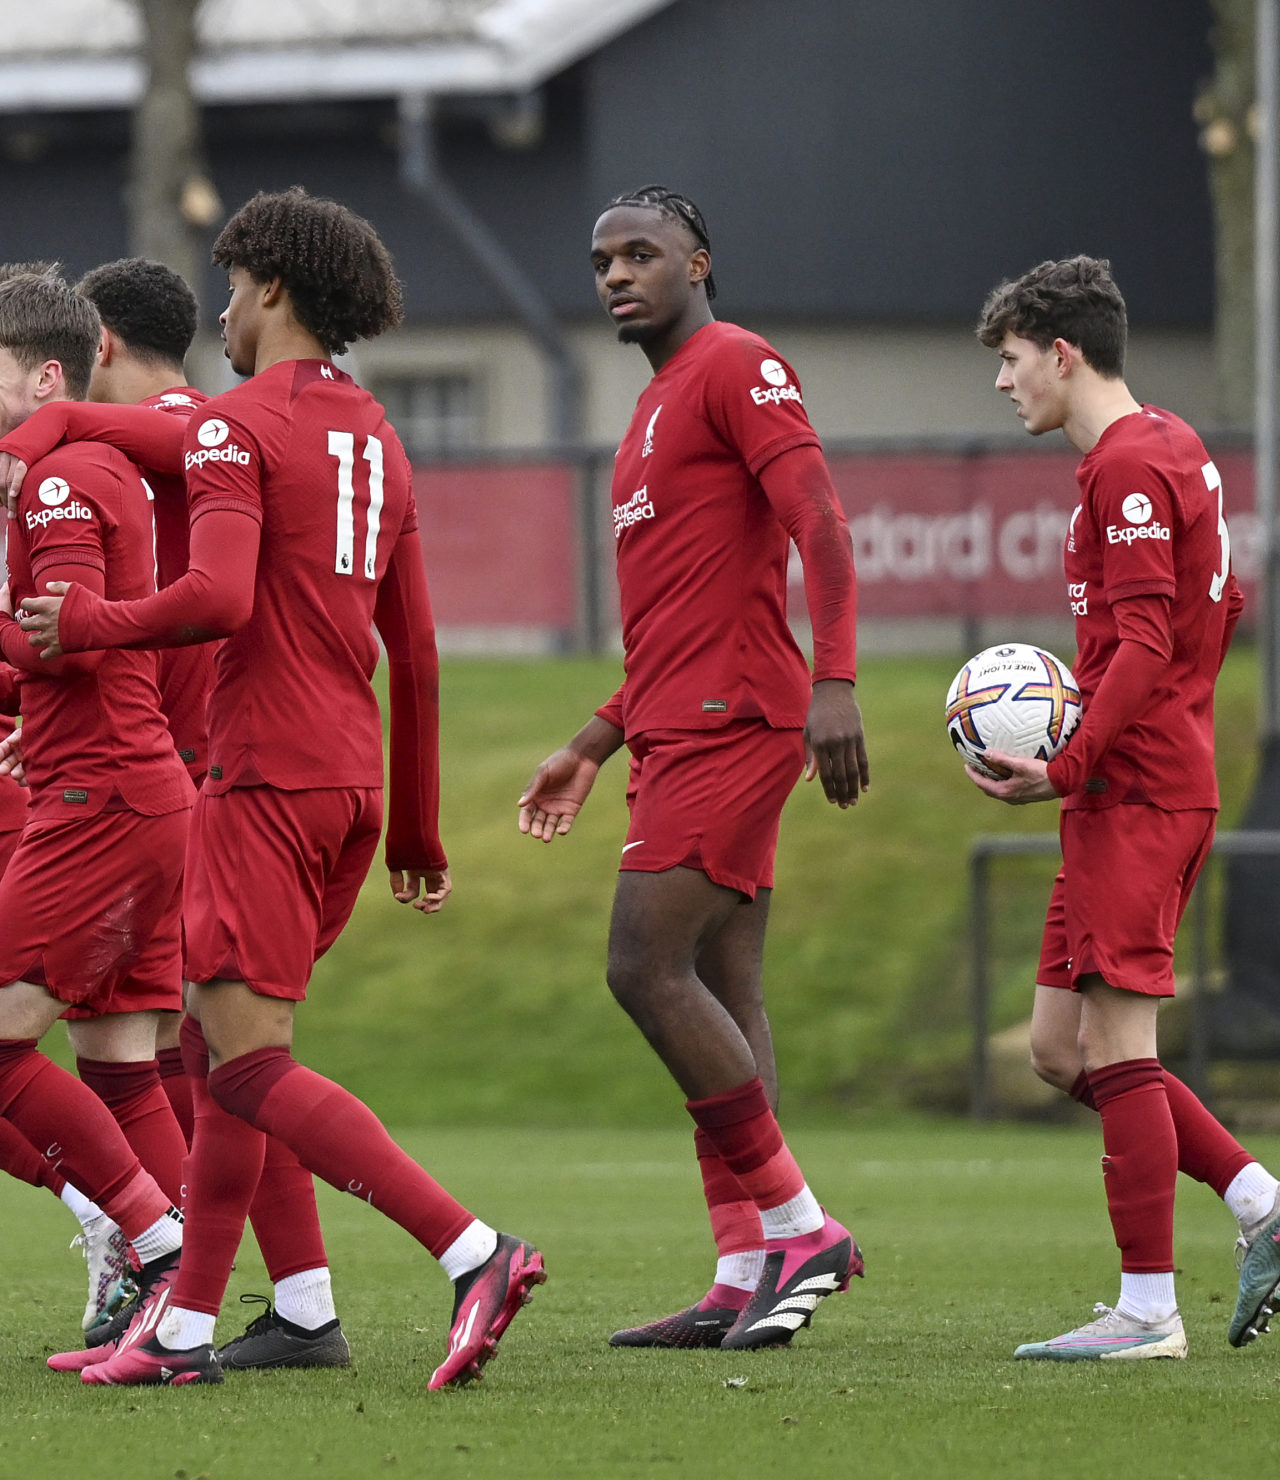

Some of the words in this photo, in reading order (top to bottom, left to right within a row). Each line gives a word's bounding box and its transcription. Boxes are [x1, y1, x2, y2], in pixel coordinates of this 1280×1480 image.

[184, 443, 251, 471] Expedia
[25, 500, 92, 530] Expedia
[327, 430, 385, 580] 11
[1106, 521, 1171, 546] Expedia
